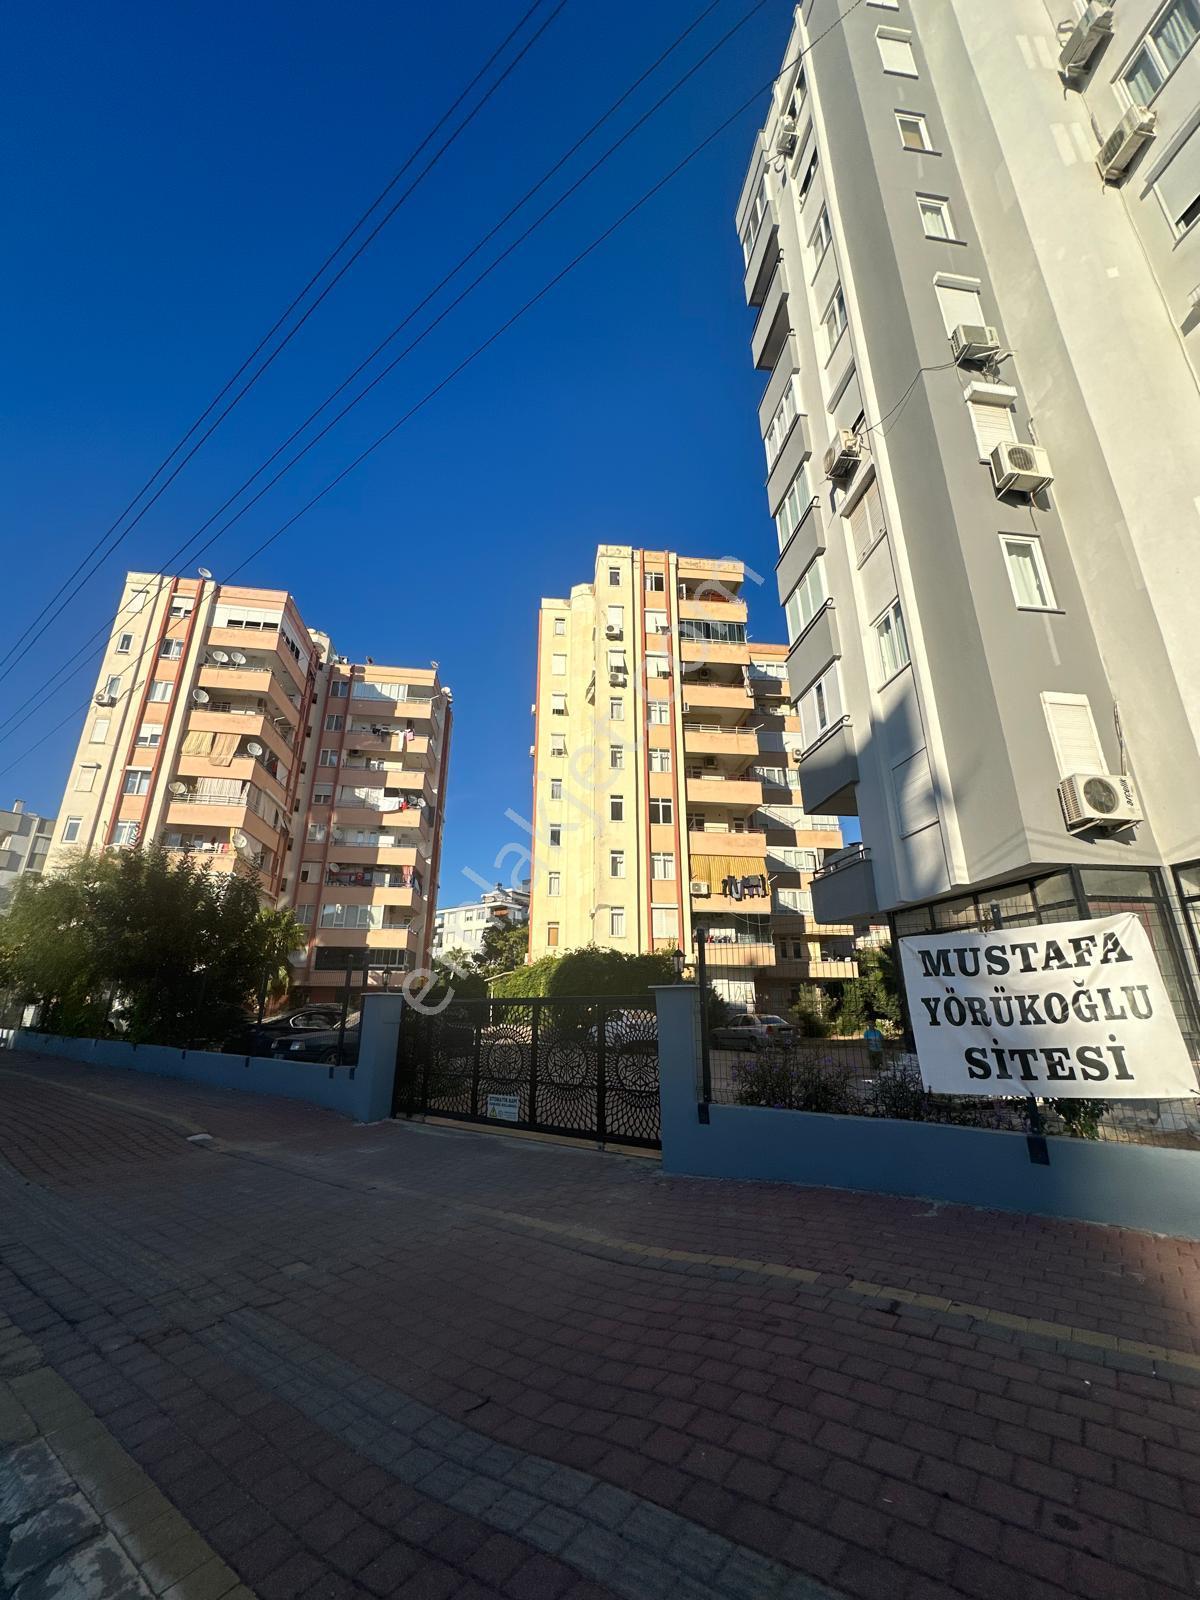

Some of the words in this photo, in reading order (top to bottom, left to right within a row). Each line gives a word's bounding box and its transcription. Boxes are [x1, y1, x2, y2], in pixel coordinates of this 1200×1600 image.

[918, 932, 1133, 977] MUSTAFA
[921, 979, 1153, 1027] YÖRÜKOĞLU
[965, 1034, 1135, 1081] SİTESİ
